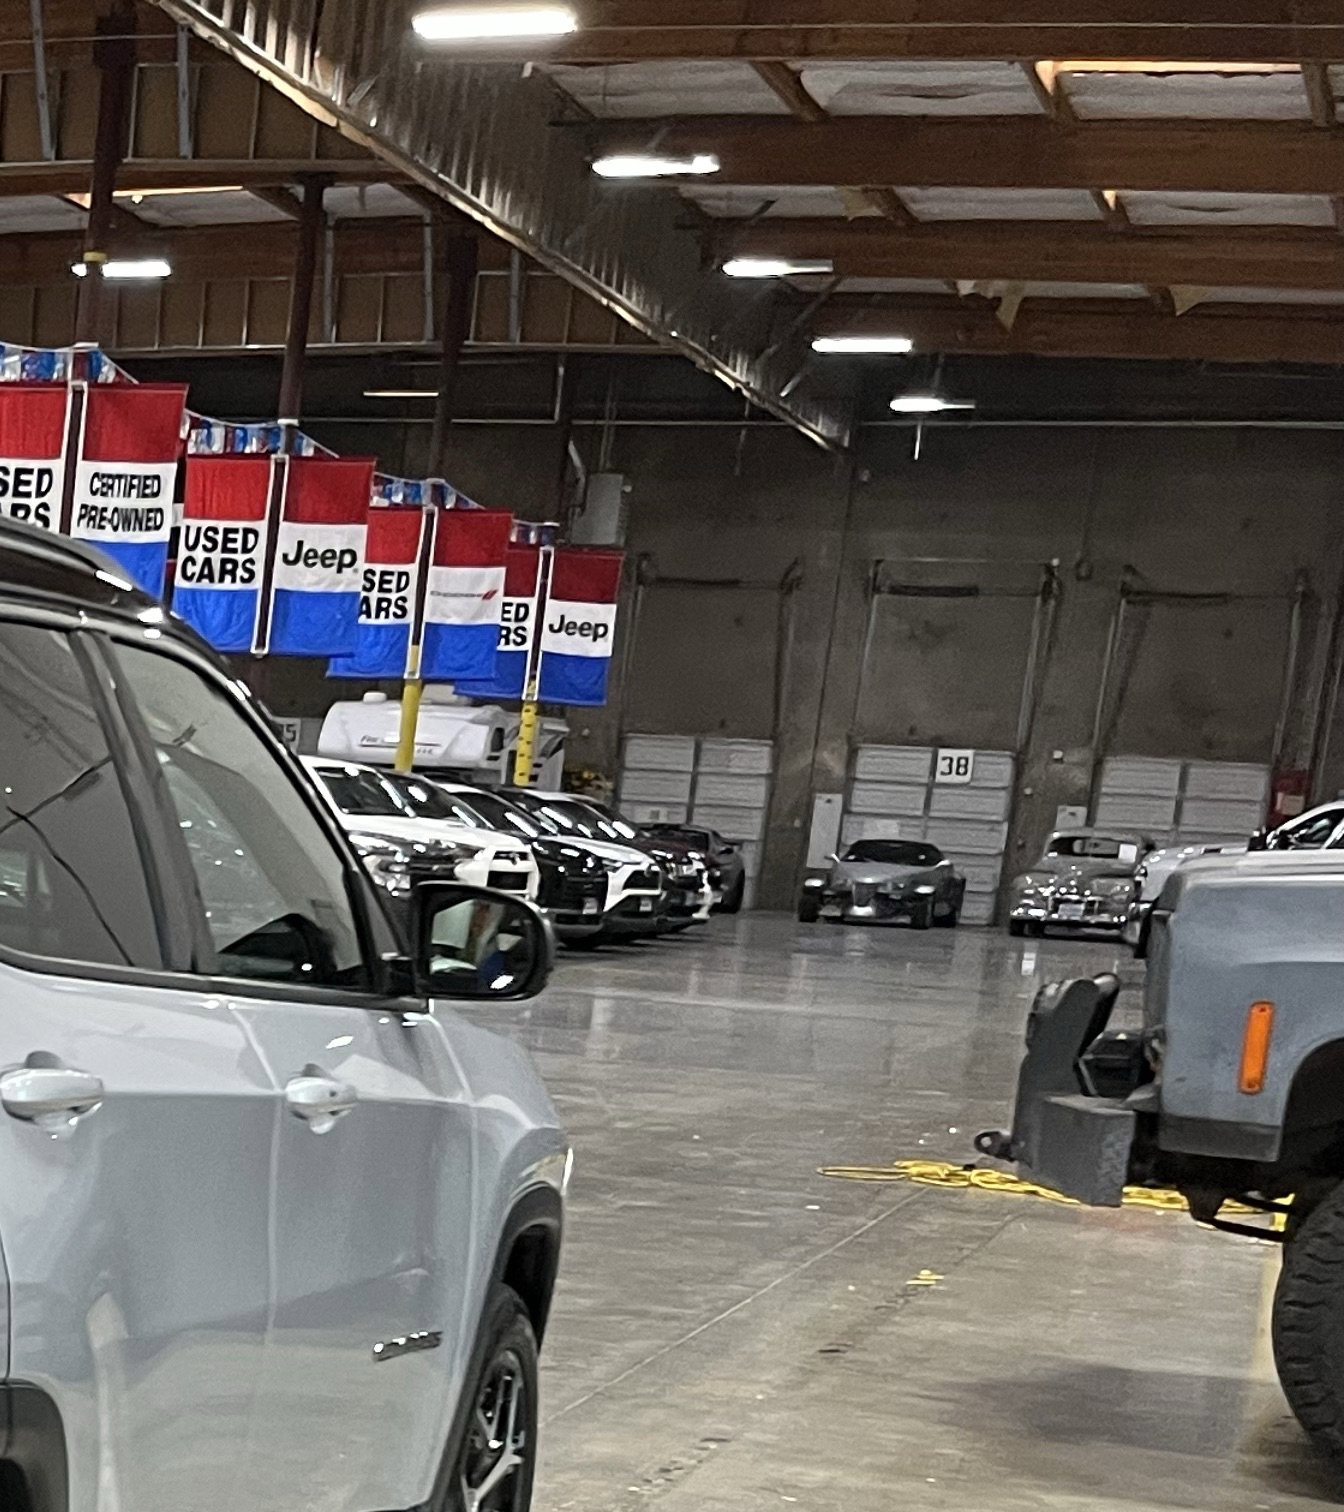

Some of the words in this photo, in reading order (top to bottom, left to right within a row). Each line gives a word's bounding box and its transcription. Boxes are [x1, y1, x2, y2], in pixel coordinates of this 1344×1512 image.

[90, 472, 161, 498] CERTIFIED
[77, 504, 162, 532] PRE-OWNED
[184, 525, 259, 554] USED
[282, 540, 357, 573] Jeep
[181, 556, 256, 584] CARS
[362, 568, 410, 593] SED
[358, 596, 408, 619] ARS
[501, 602, 529, 622] ED
[500, 625, 527, 646] RS
[549, 614, 608, 642] Jeep
[940, 756, 969, 776] 38
